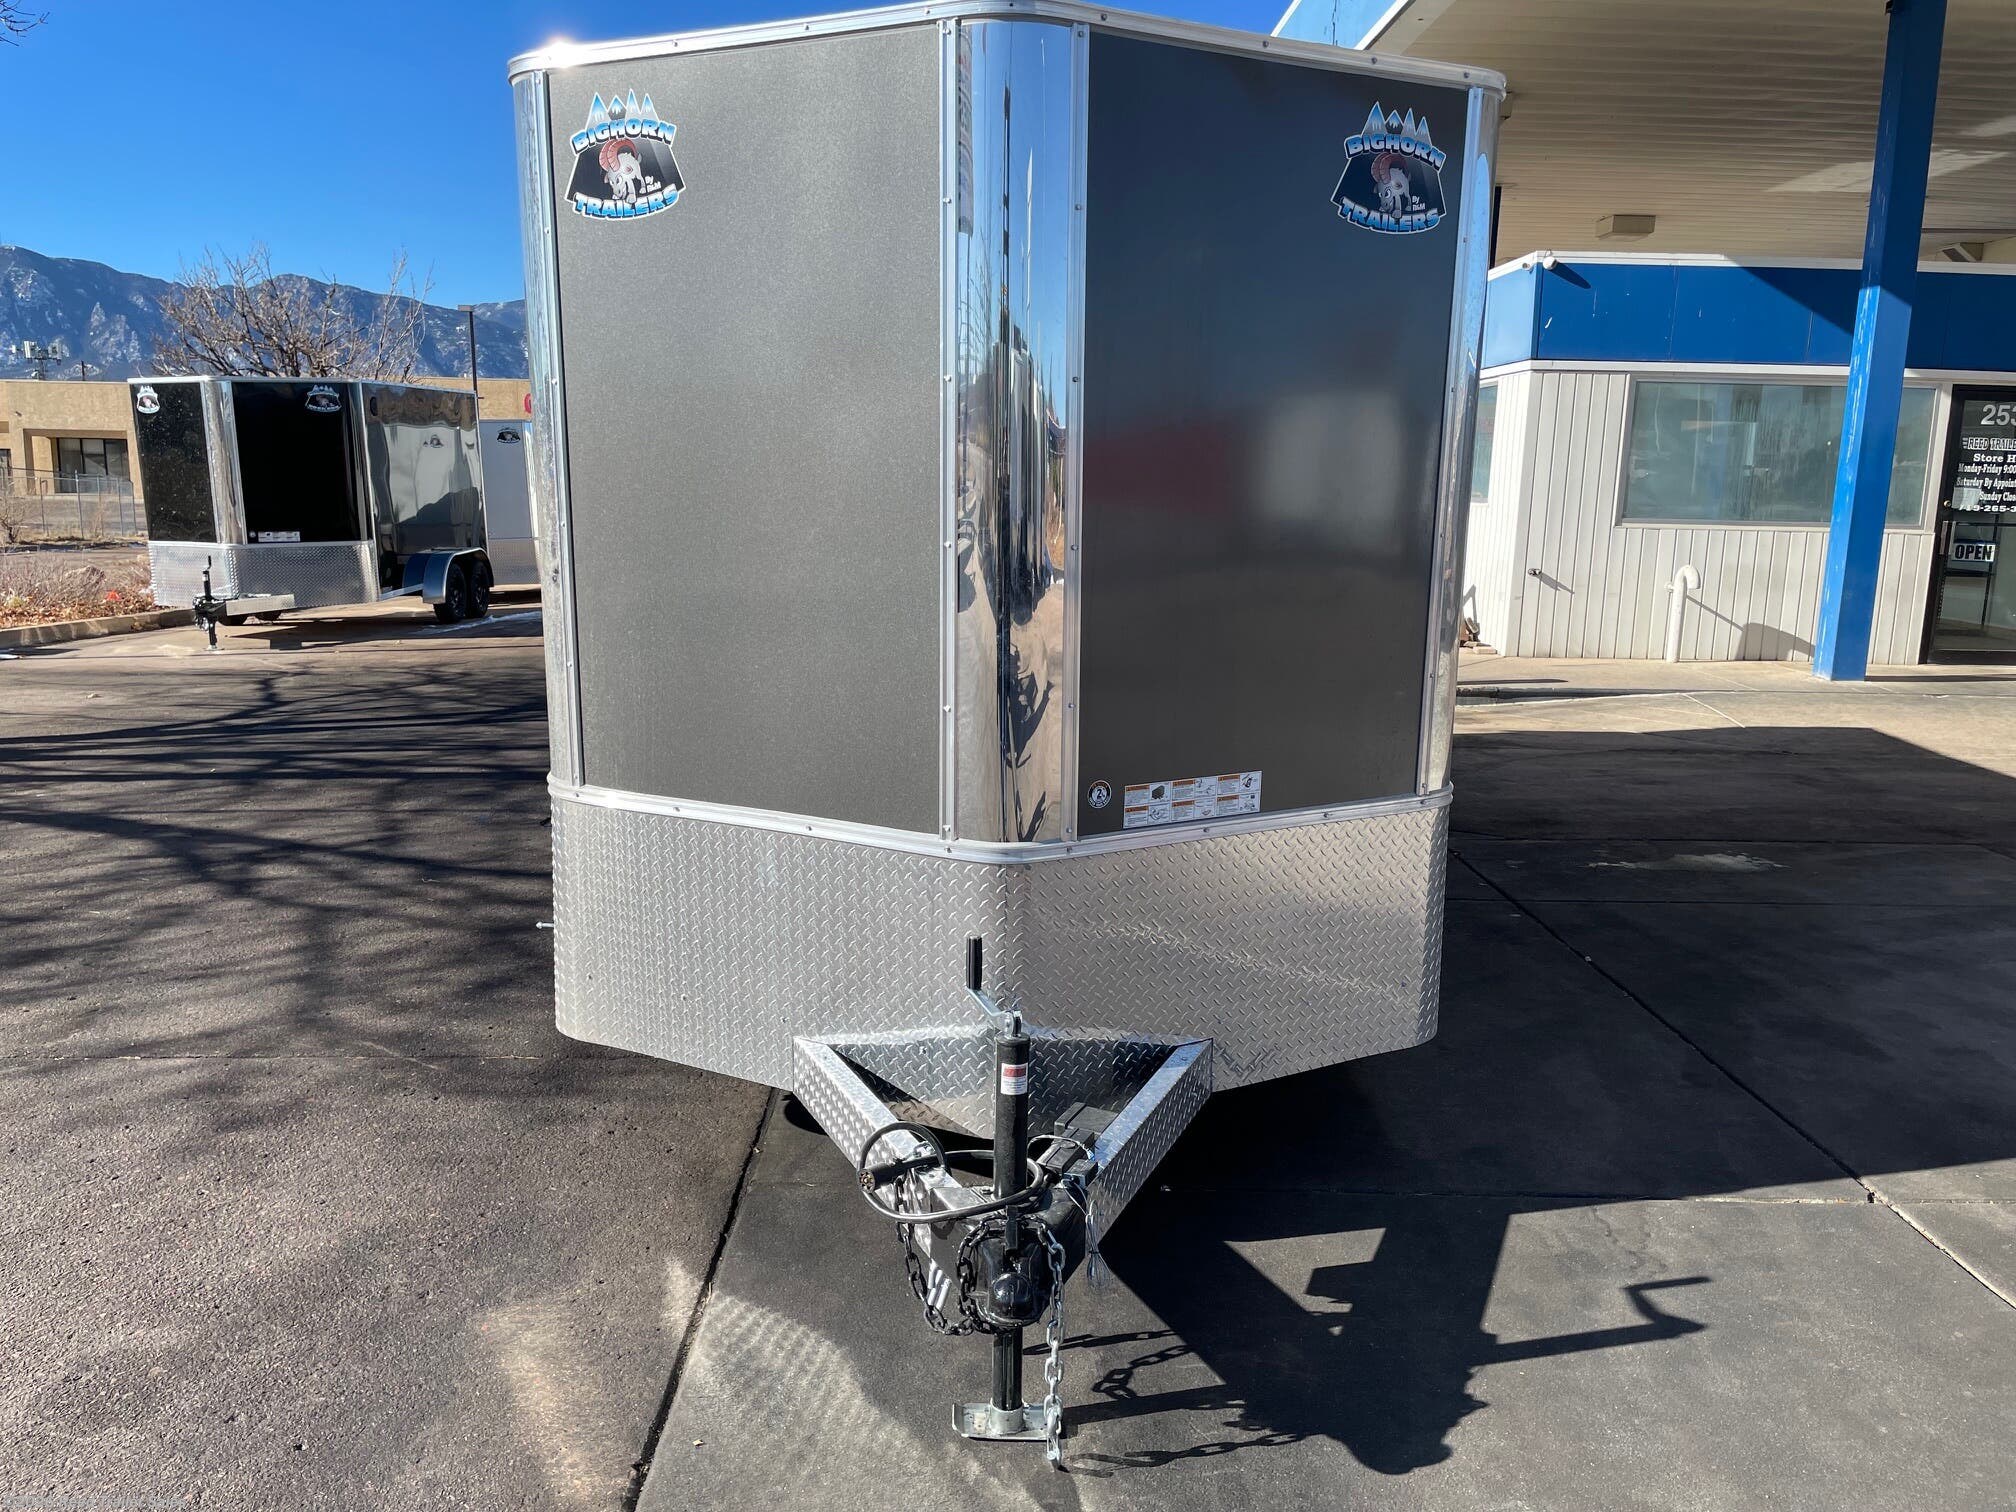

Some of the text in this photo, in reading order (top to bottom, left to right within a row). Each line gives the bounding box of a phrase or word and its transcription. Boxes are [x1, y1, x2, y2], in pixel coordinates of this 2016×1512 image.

[572, 118, 676, 152] BIGHORN
[1346, 134, 1446, 171] BIGHORN
[574, 184, 679, 218] TRAILERS
[1341, 197, 1439, 232] TRAILERS
[1968, 437, 1989, 449] REED
[1973, 453, 2004, 462] Store
[1957, 463, 2002, 475] Monday-Friday
[1956, 477, 1983, 489] Saturday
[1984, 478, 1993, 489] By
[1979, 491, 2002, 503] Sunday
[1955, 544, 1992, 560] OPEN
